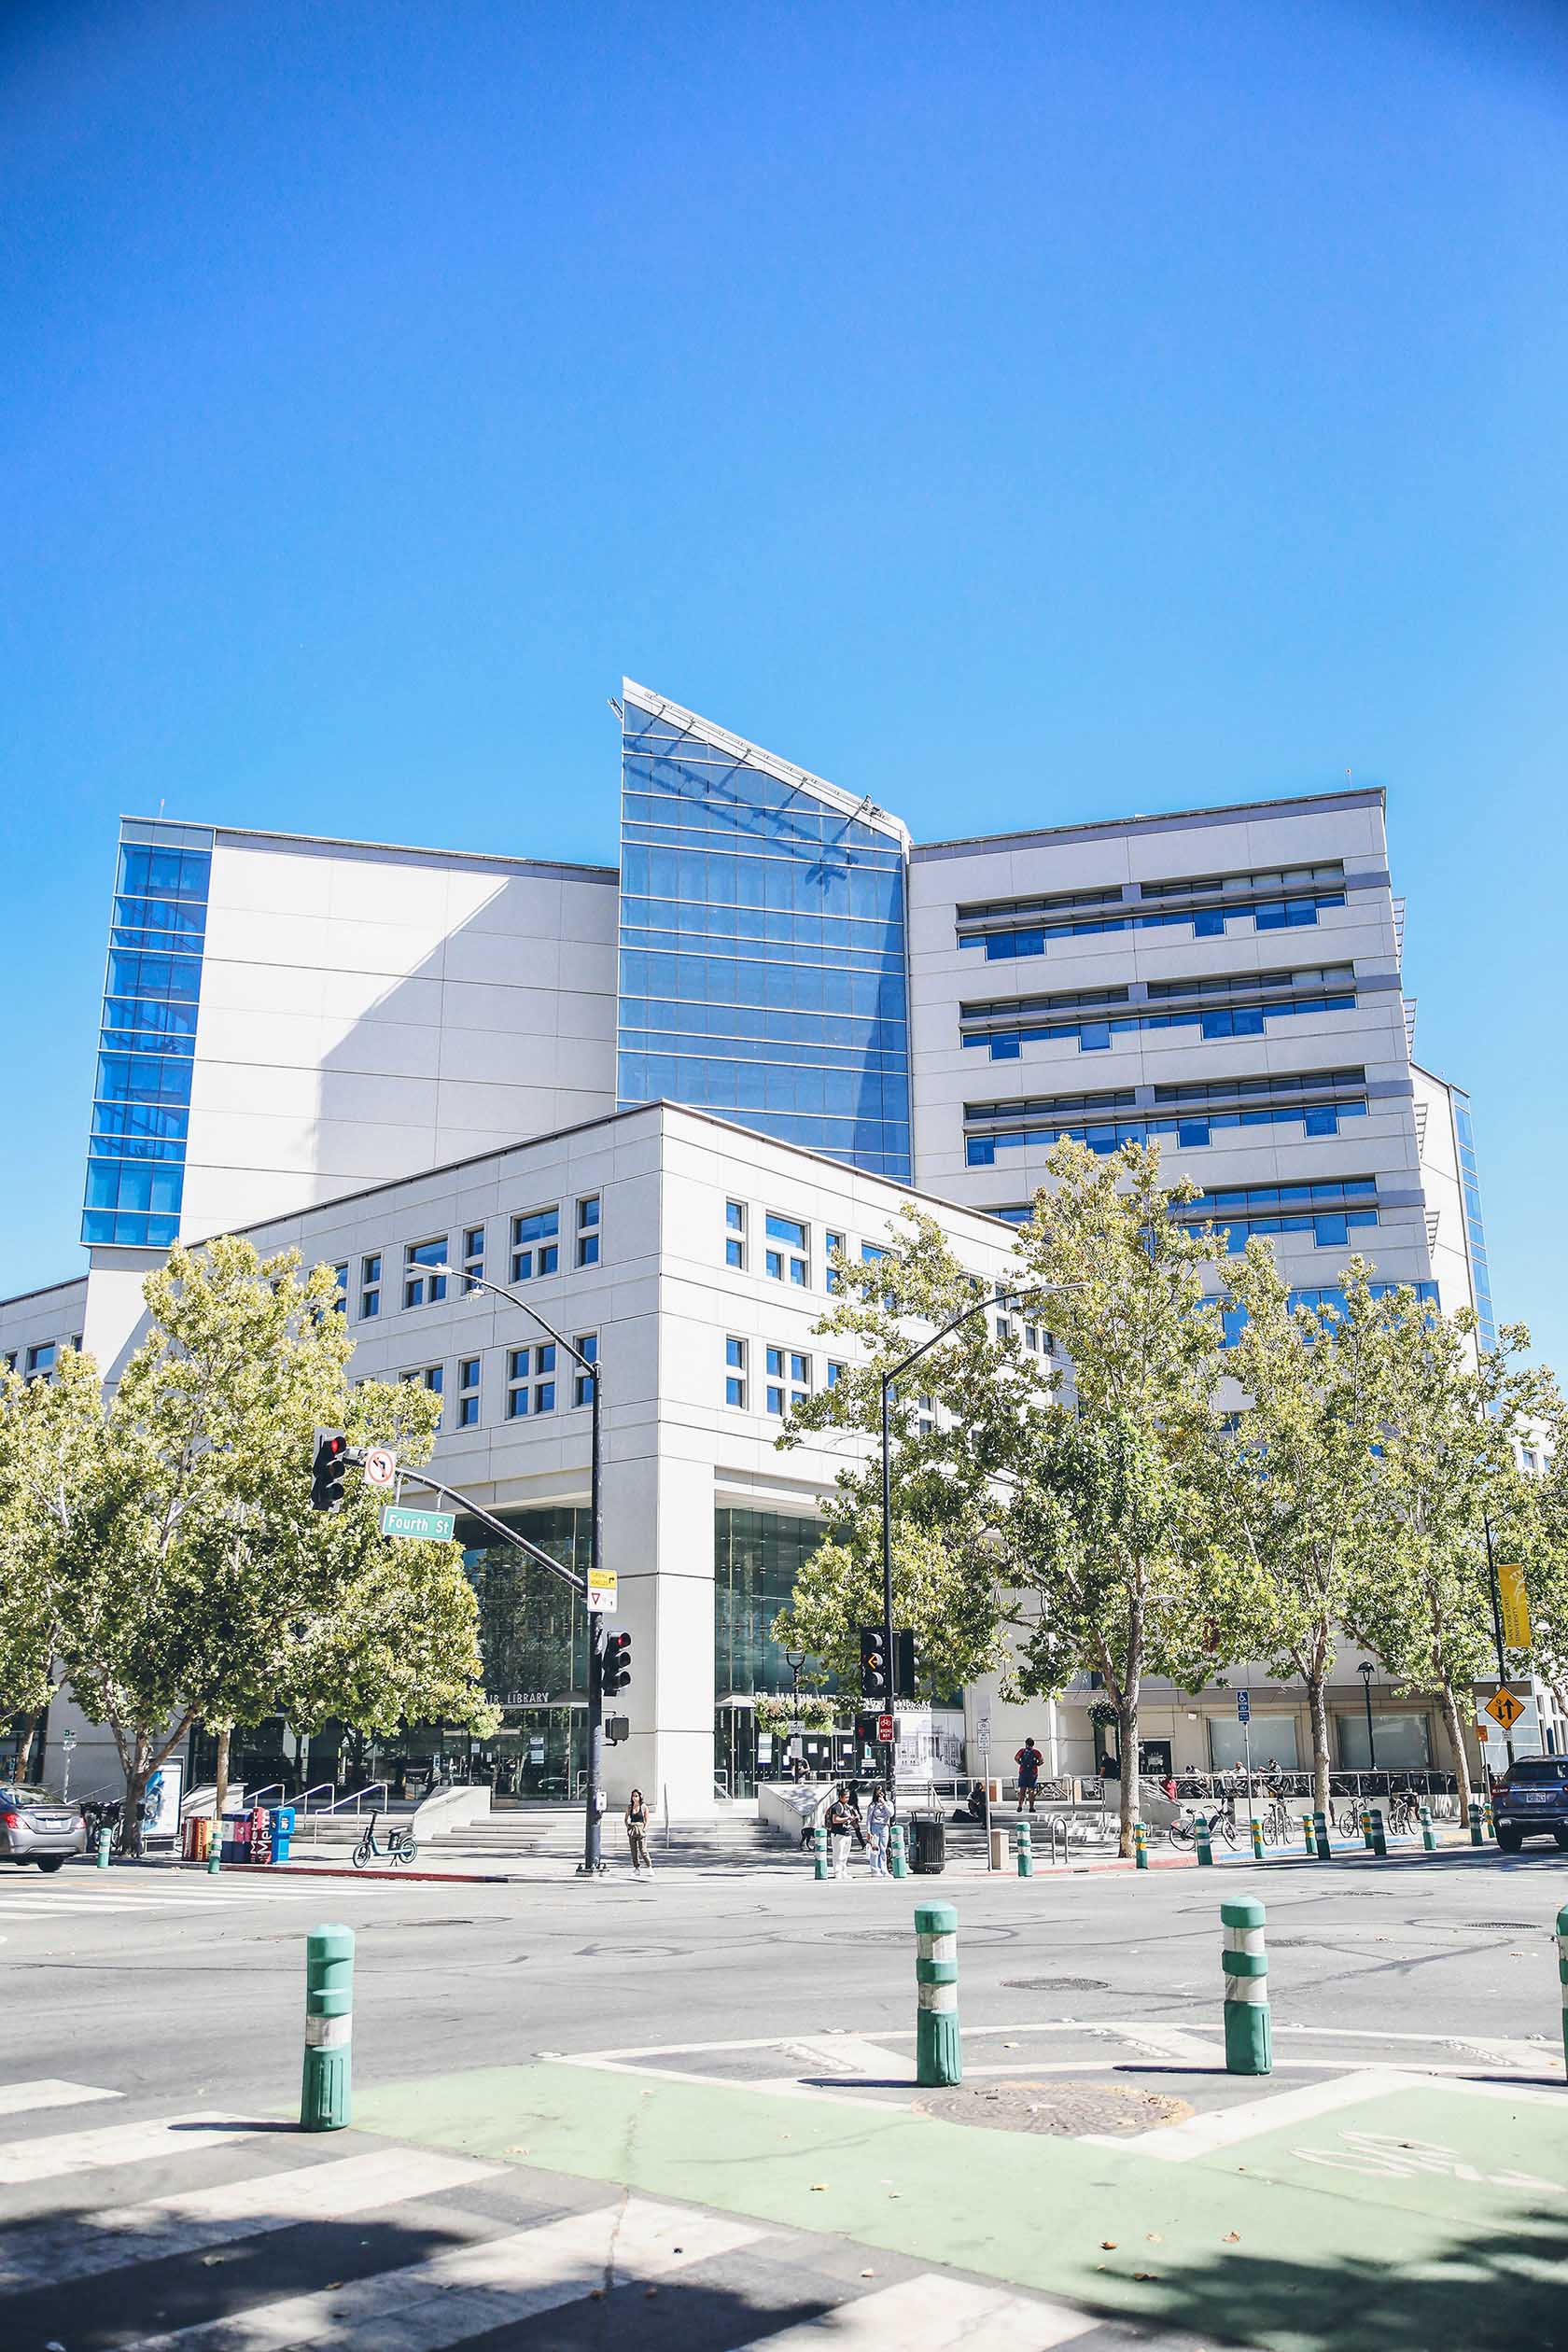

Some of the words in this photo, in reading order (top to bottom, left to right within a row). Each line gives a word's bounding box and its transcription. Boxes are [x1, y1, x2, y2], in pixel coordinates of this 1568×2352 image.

[388, 1514, 428, 1532] Fourth
[435, 1519, 449, 1534] St
[507, 1692, 549, 1704] LIBRARY
[257, 1810, 272, 1855] Metro
